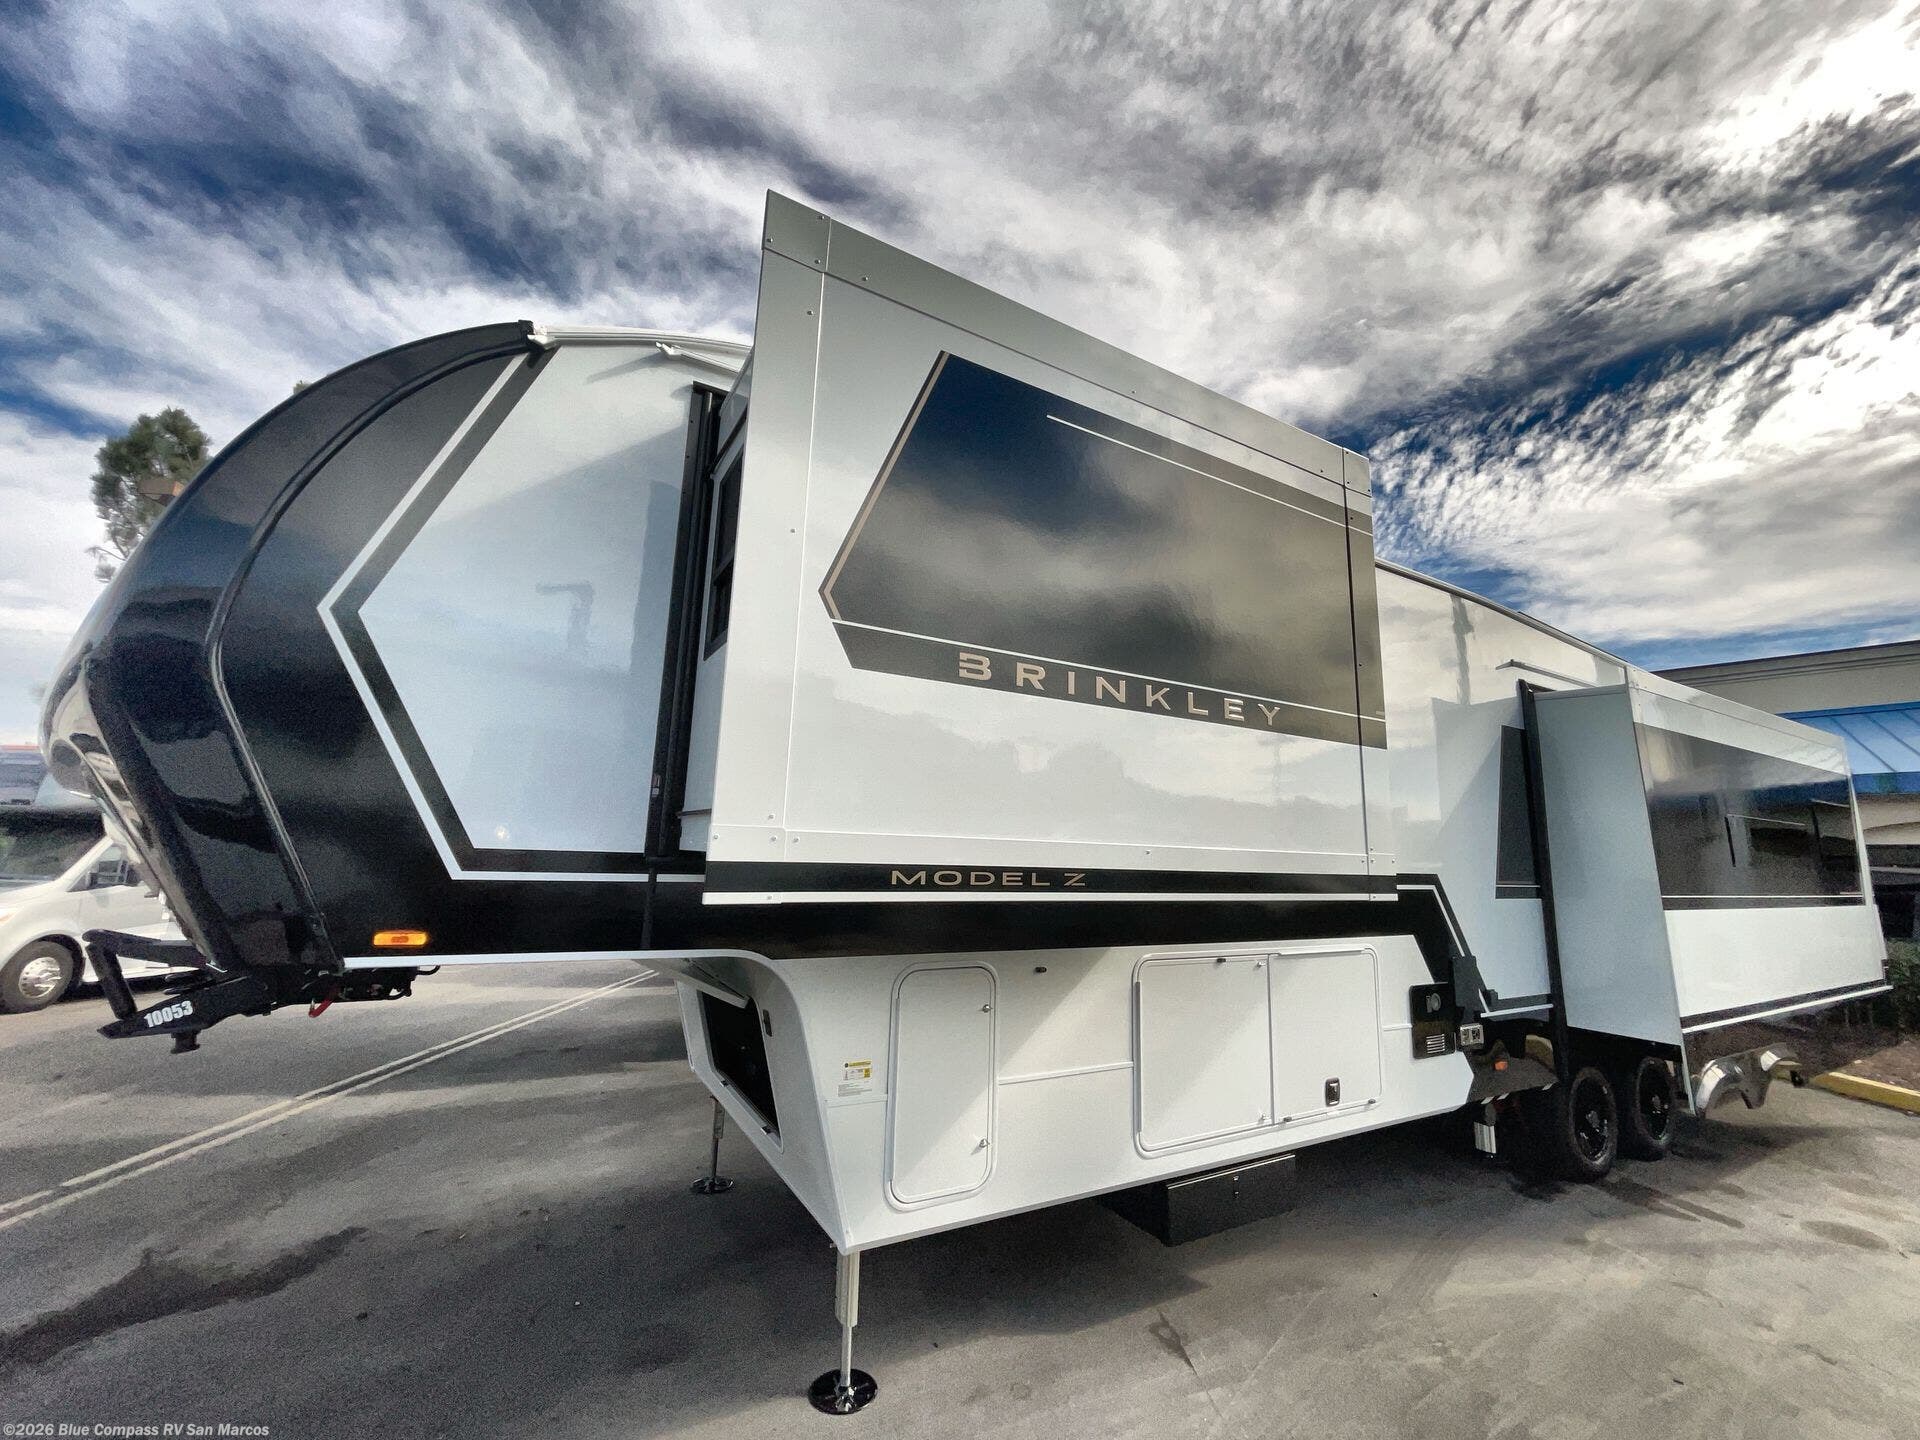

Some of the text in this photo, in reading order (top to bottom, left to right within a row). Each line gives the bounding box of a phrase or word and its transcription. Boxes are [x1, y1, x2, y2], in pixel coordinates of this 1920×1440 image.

[958, 651, 1281, 726] BRINKLEY
[891, 870, 1086, 887] MODEL Z
[143, 1000, 194, 1028] 10053
